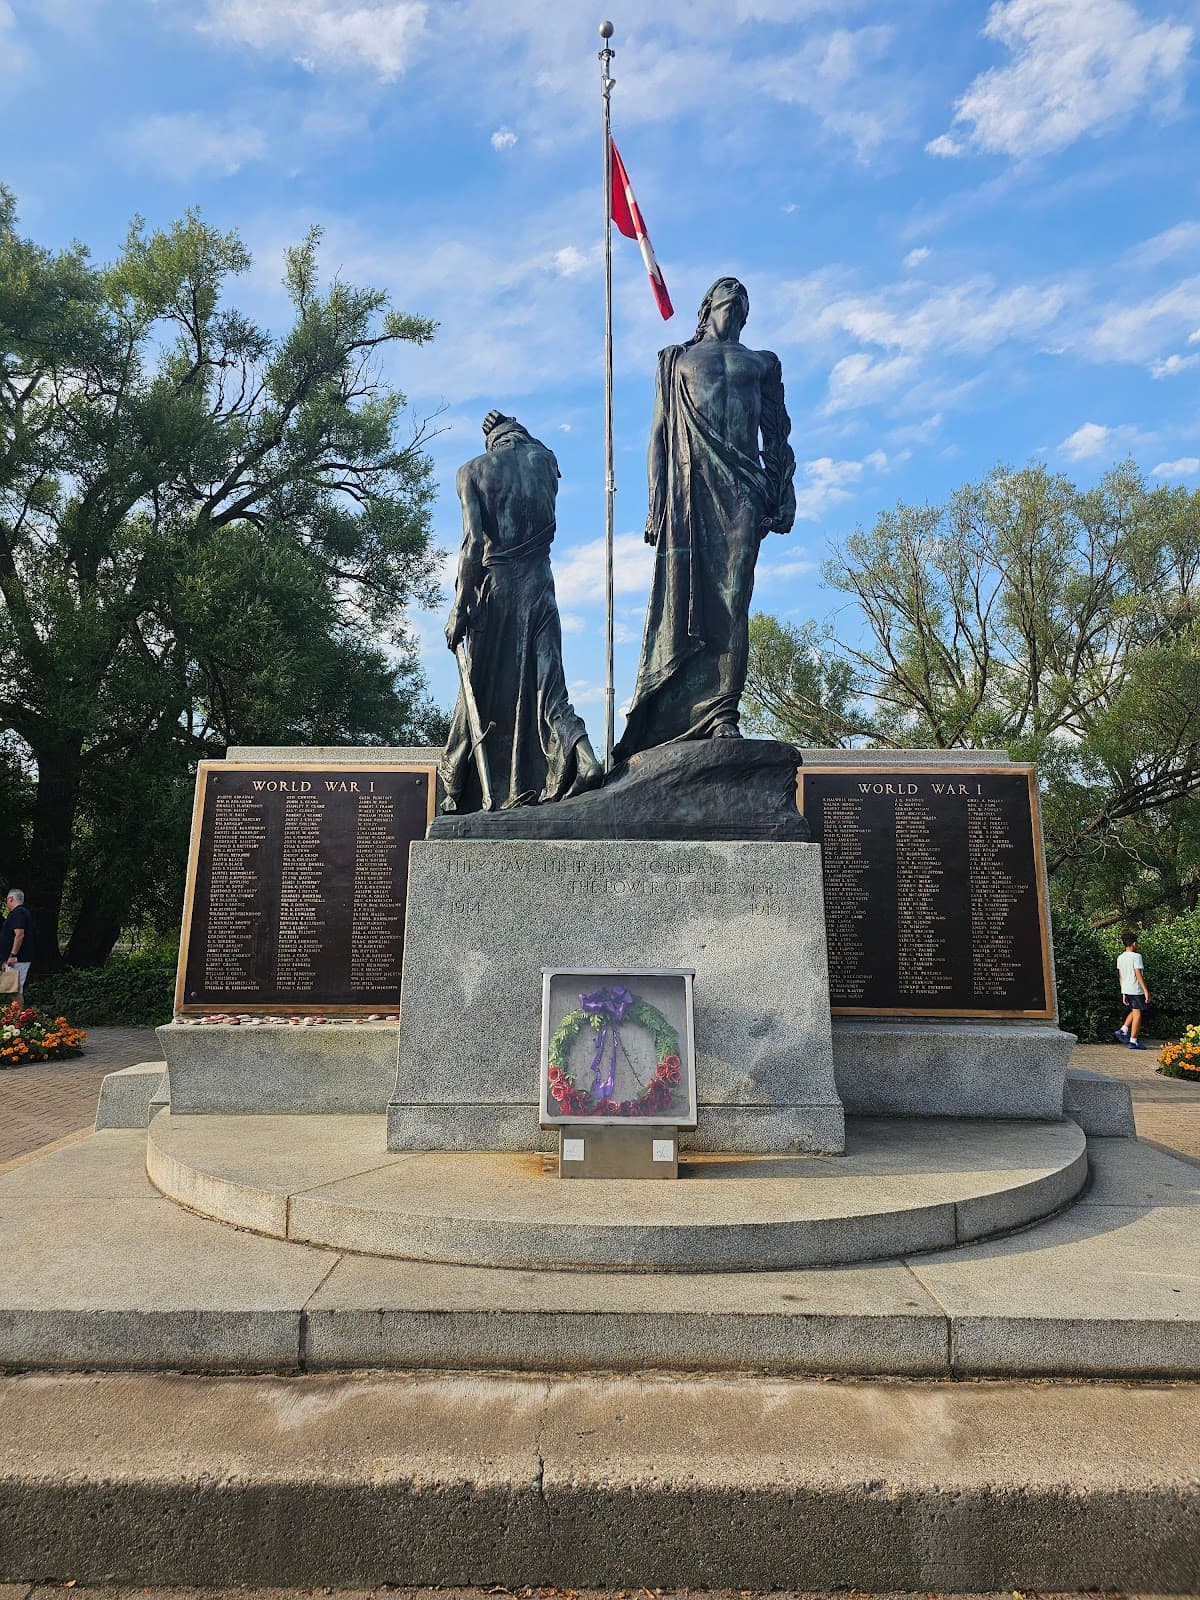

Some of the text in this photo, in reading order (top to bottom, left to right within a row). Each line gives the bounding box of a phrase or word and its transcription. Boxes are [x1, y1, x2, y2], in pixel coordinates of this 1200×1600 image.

[252, 781, 375, 793] WORLD WAR I
[858, 783, 982, 795] WORLD WAR I
[446, 860, 486, 873] THEY
[543, 860, 586, 873] THEIR
[594, 860, 636, 874] LIVES
[642, 861, 663, 874] TO
[666, 860, 723, 874] BREAK
[569, 880, 788, 895] THE POWER OF THE SWORD
